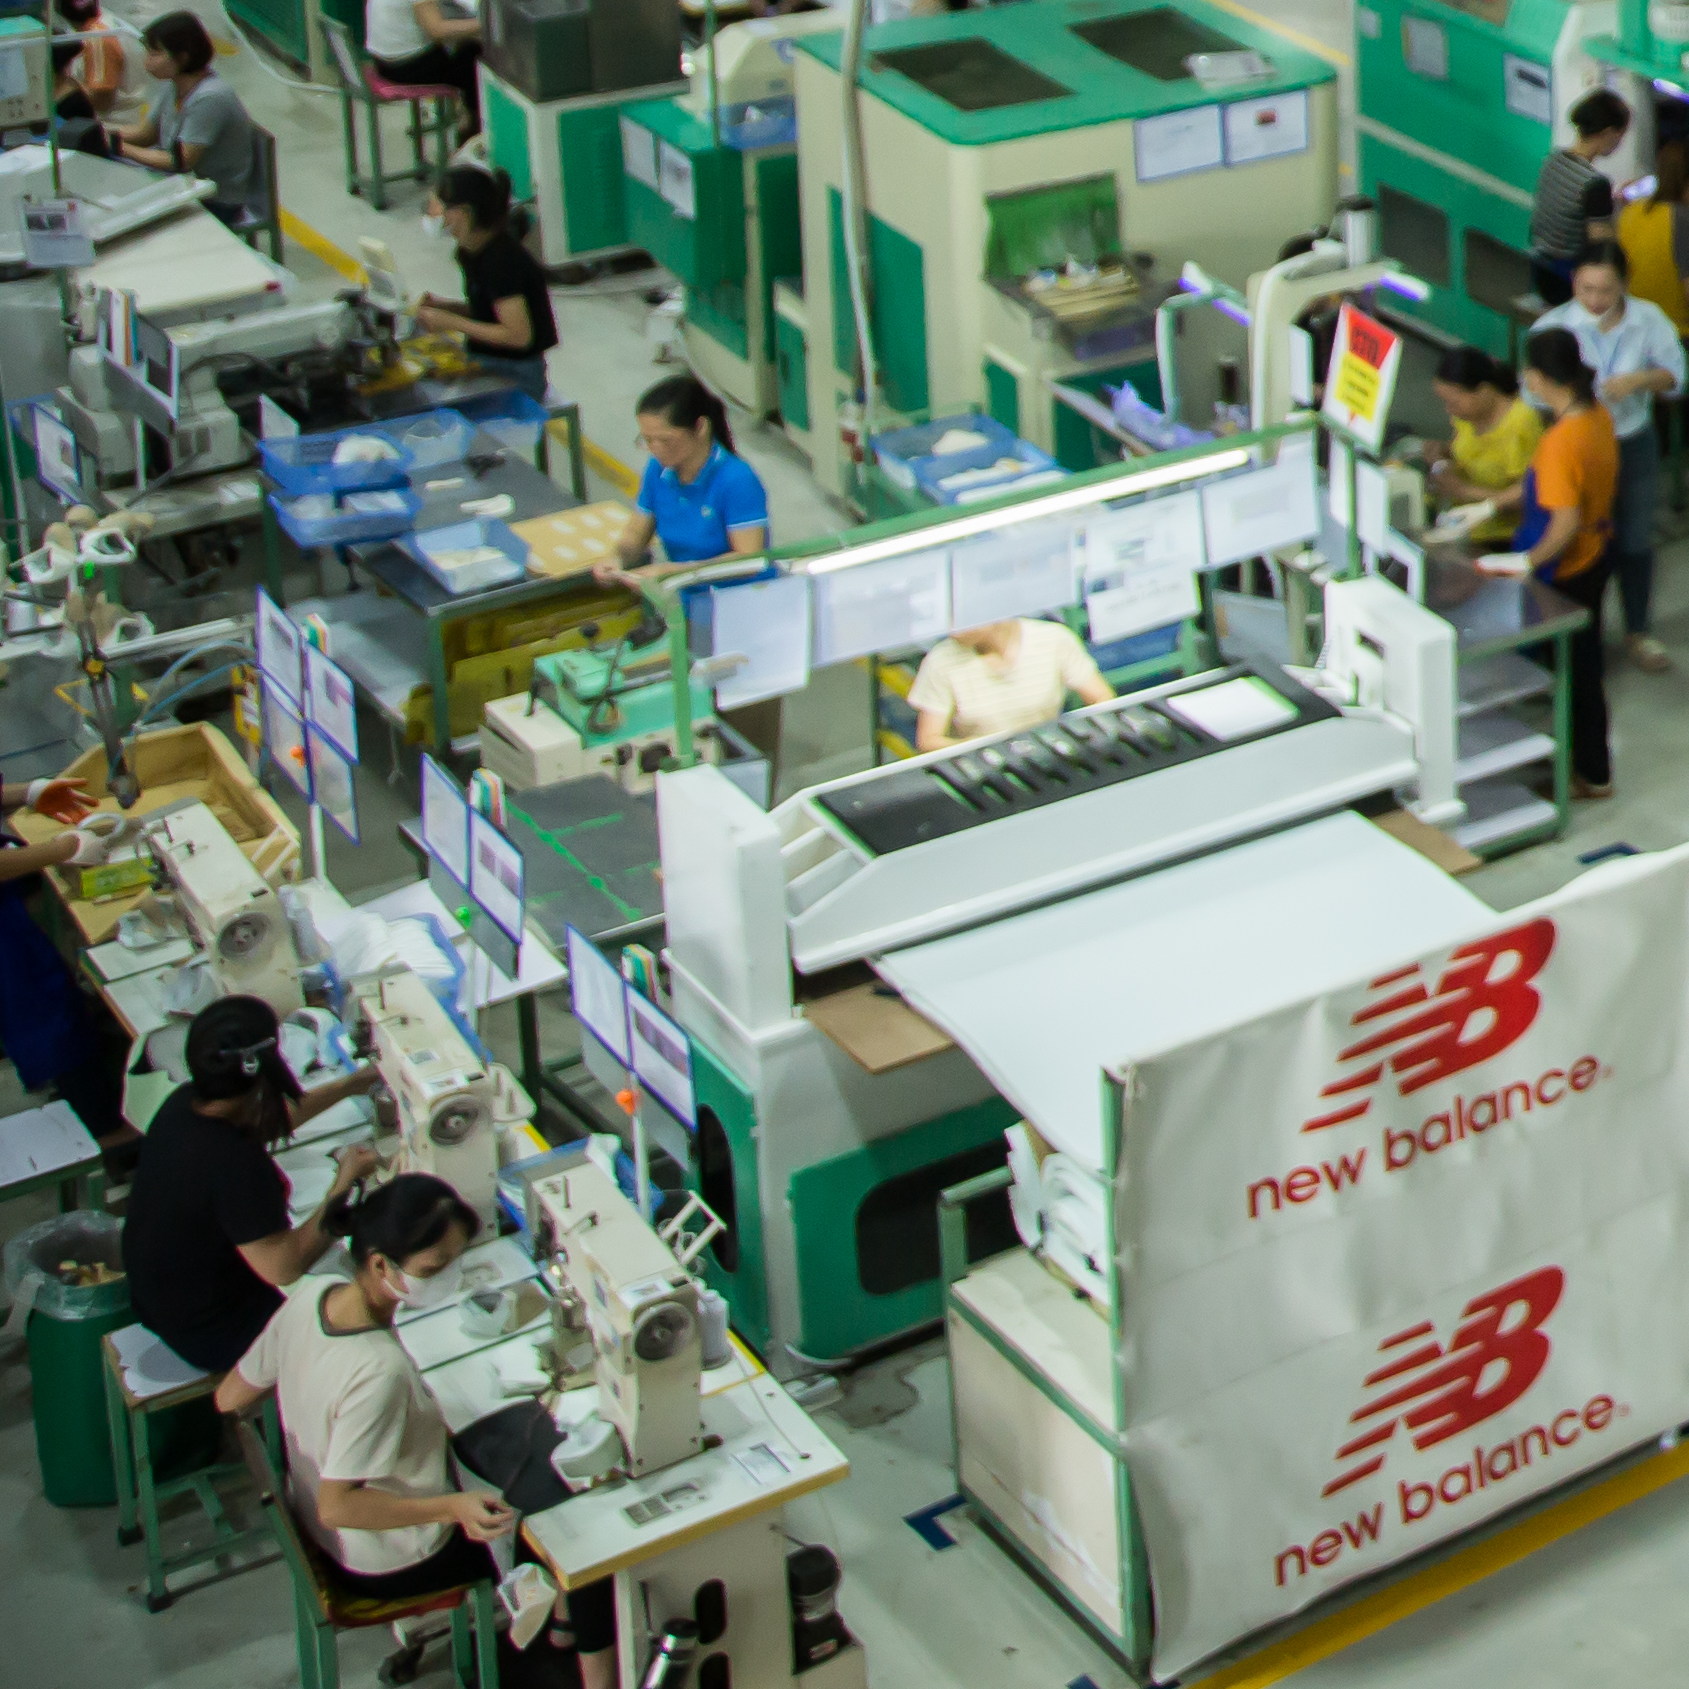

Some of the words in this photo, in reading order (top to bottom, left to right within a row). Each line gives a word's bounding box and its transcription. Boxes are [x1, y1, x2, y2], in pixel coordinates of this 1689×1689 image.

[1248, 1148, 1367, 1219] new
[1384, 1054, 1602, 1172] balance
[1275, 1500, 1383, 1586] new
[1398, 1392, 1615, 1524] balance
